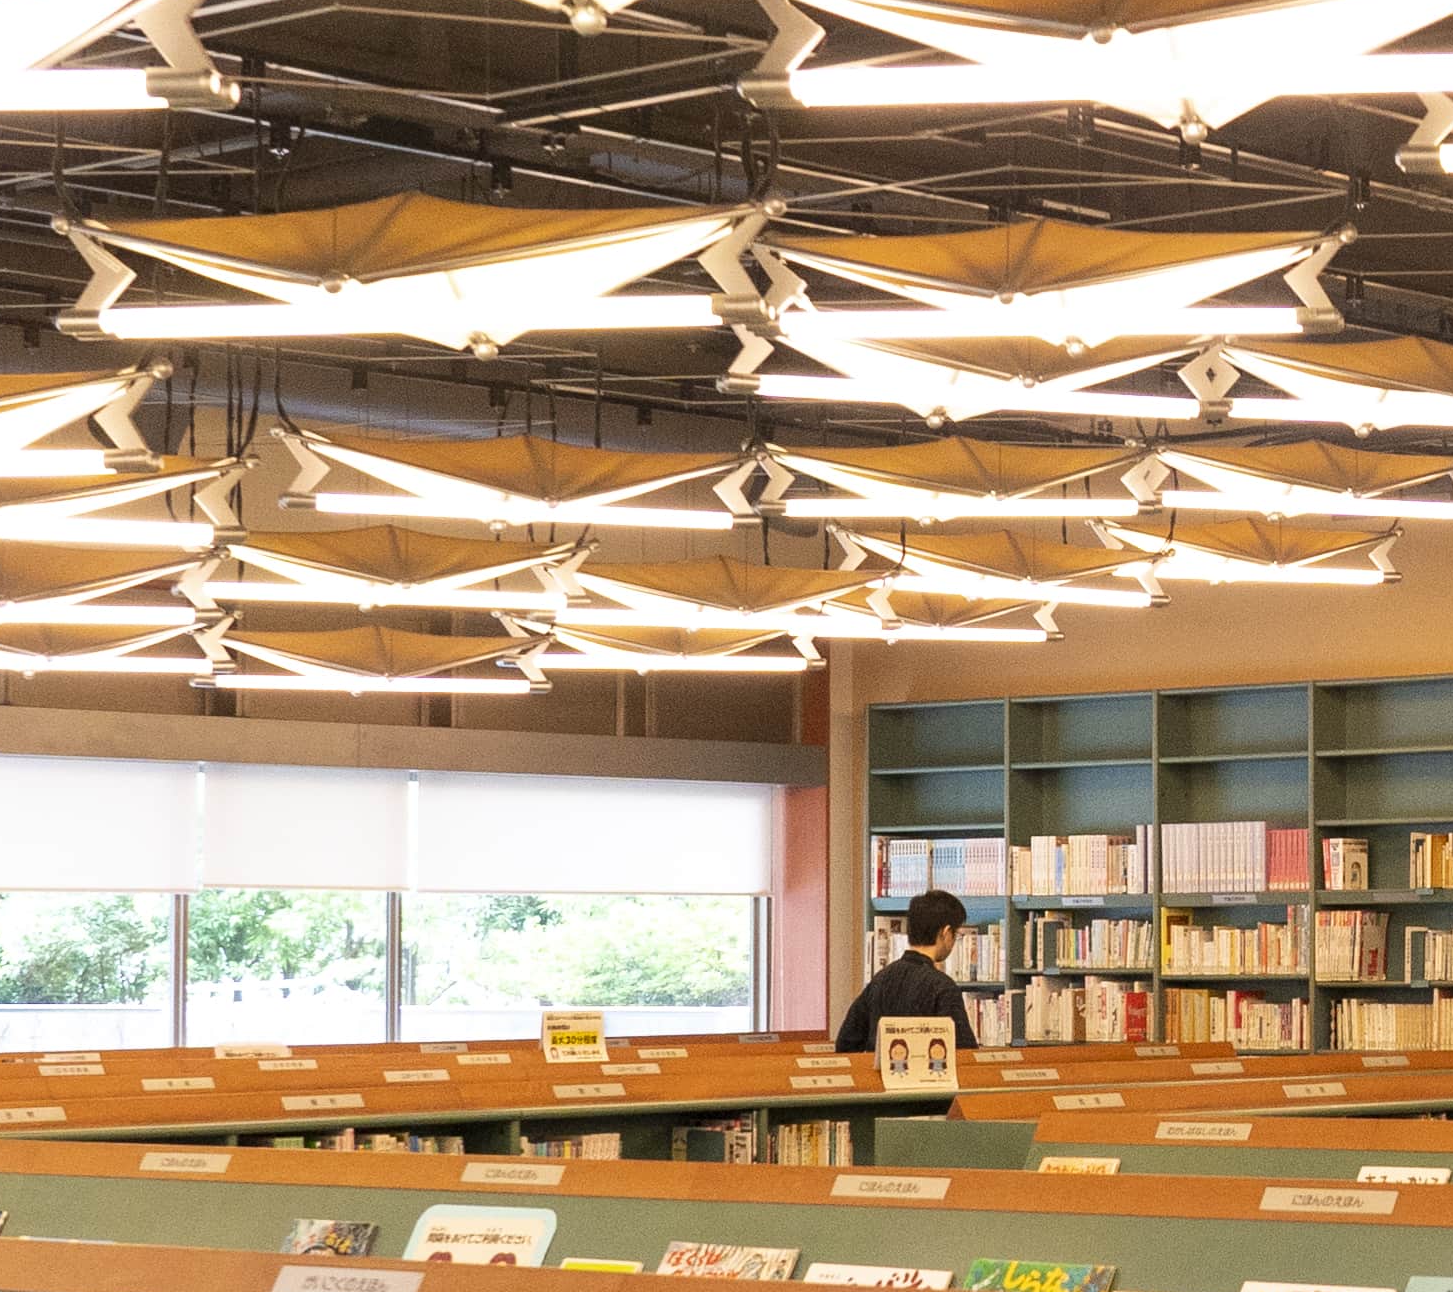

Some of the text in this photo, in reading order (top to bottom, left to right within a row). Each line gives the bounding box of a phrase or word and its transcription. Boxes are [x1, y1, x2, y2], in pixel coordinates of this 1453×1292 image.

[1290, 1193, 1365, 1208] にほんのえほん
